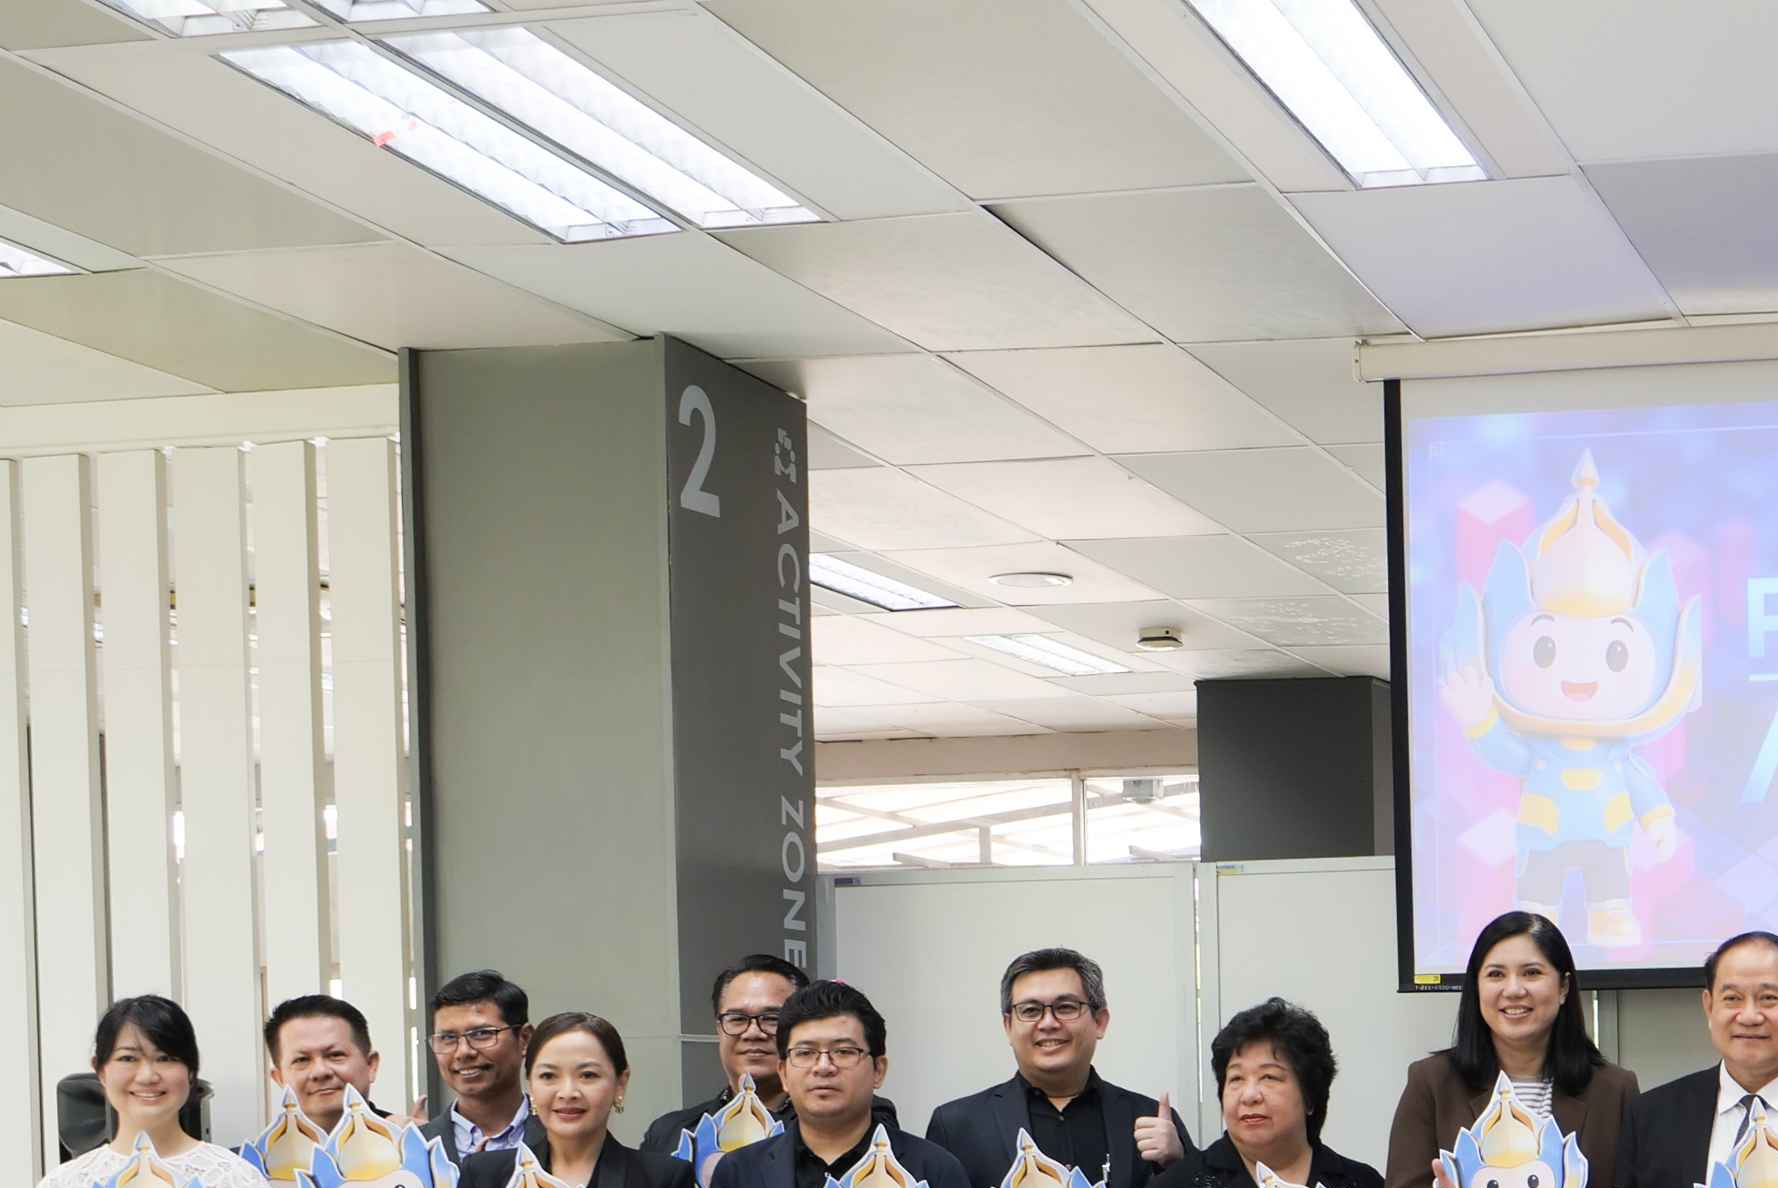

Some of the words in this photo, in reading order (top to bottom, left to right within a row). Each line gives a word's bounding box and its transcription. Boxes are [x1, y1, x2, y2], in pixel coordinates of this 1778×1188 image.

[678, 384, 721, 519] 2
[776, 488, 804, 777] ACTIVITY
[781, 794, 808, 969] ZONE
